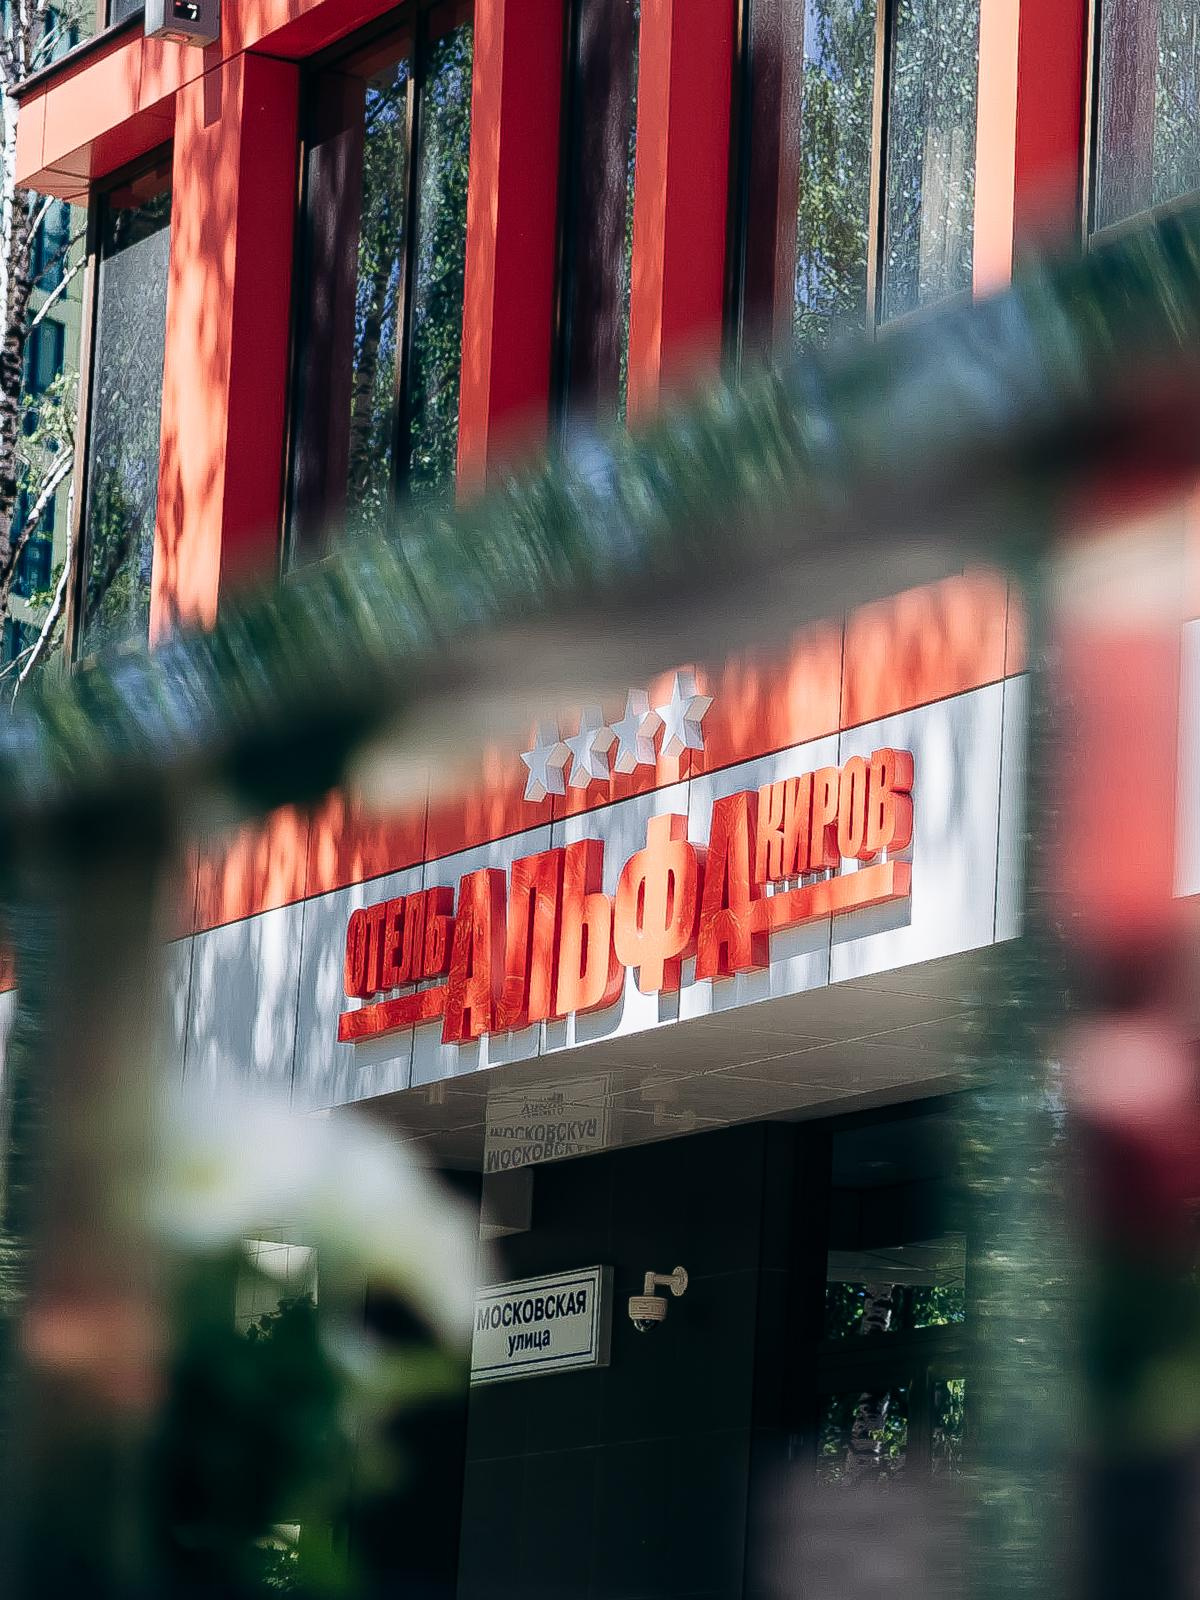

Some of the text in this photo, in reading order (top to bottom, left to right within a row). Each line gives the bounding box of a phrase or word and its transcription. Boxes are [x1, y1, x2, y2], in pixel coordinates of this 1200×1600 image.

[343, 747, 915, 1045] ОТЕЛЬ АЛЬФА КИРОВ
[477, 1289, 587, 1331] МОСКОВСКАЯ
[508, 1329, 551, 1358] улица
